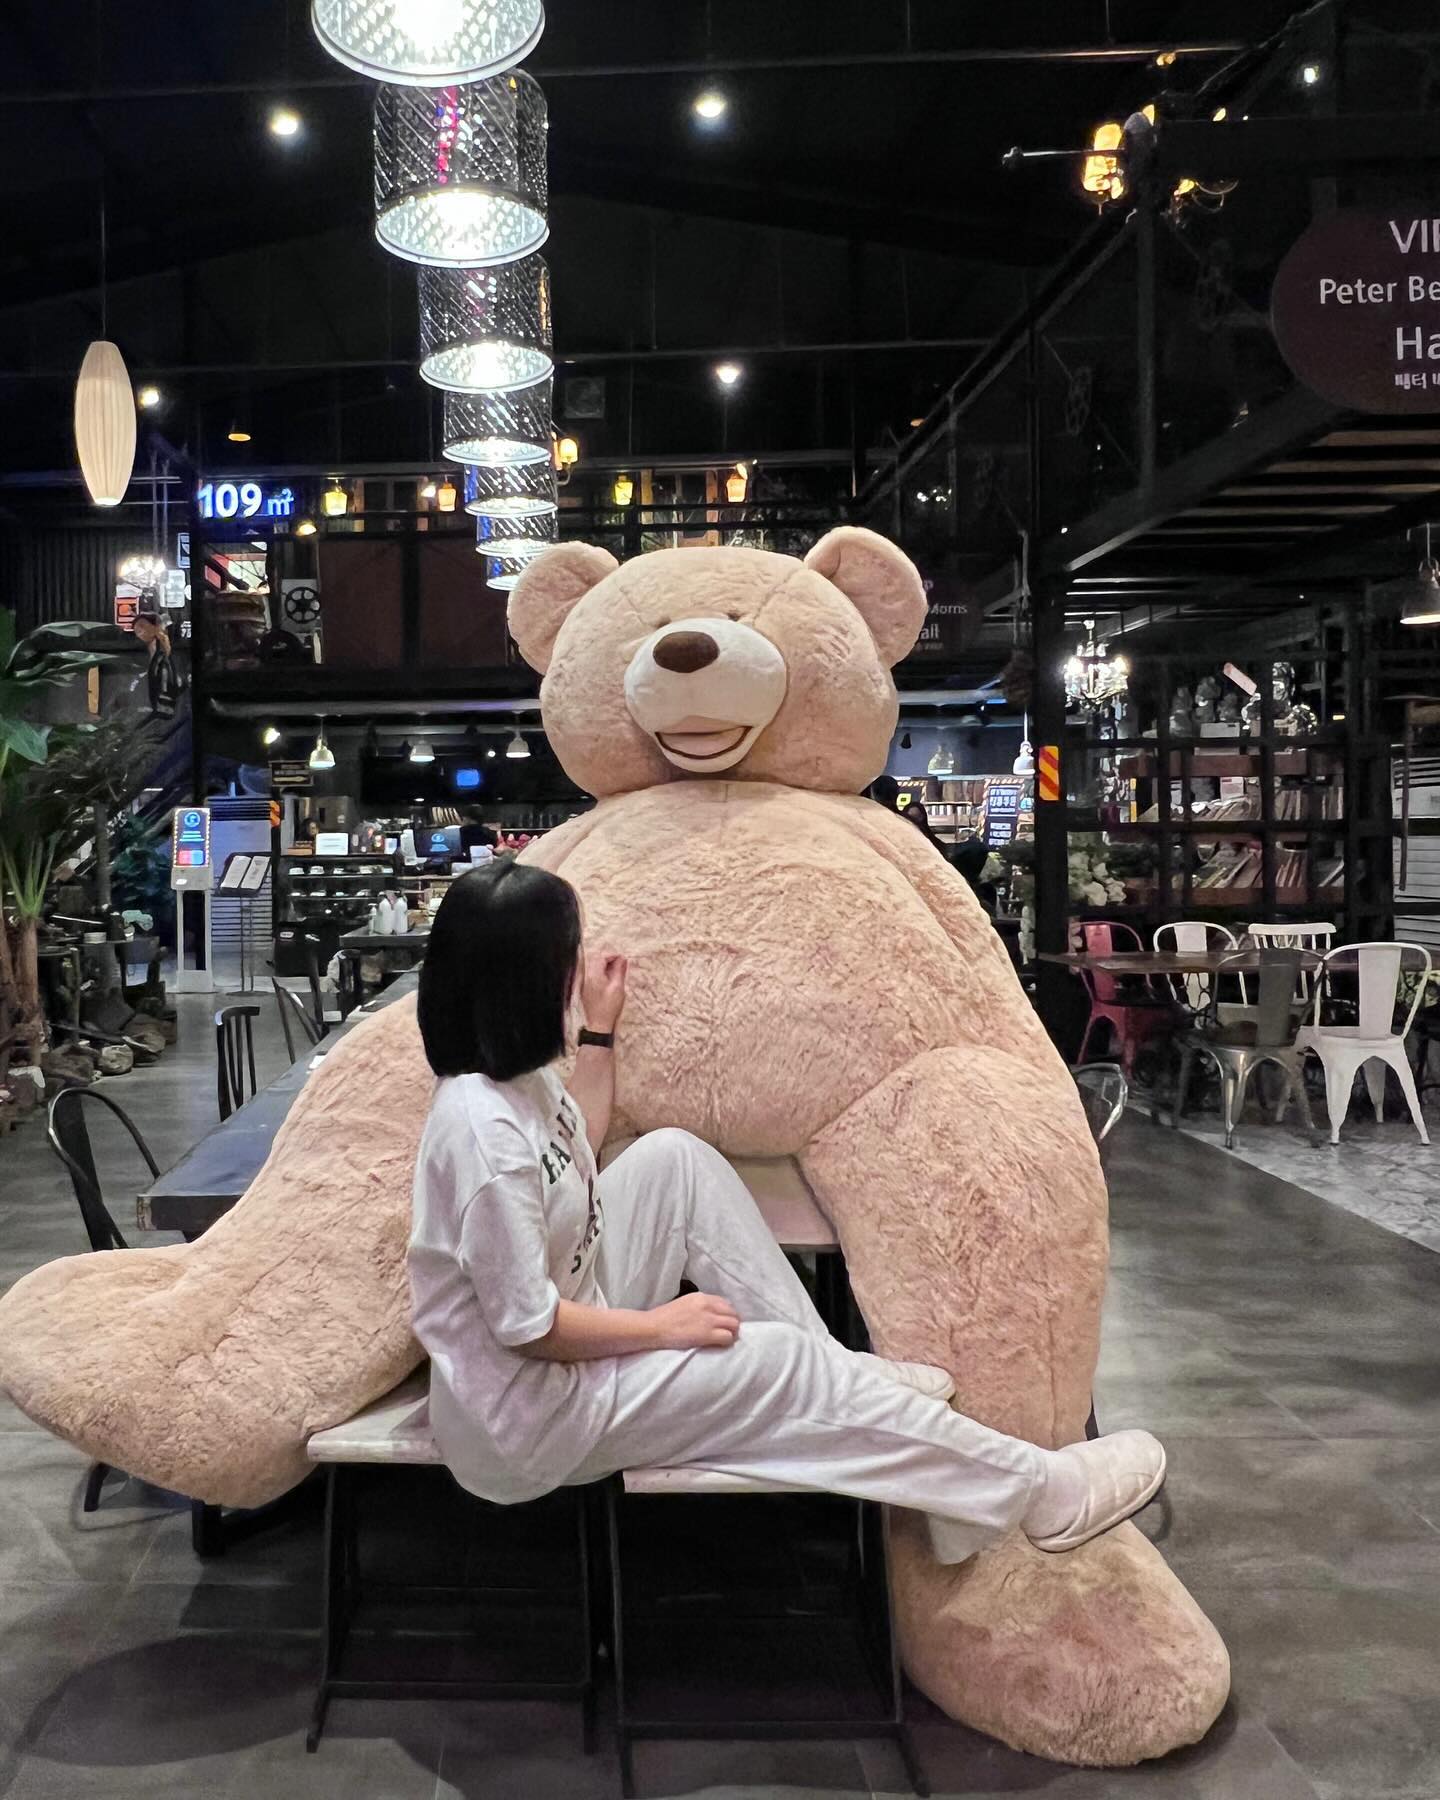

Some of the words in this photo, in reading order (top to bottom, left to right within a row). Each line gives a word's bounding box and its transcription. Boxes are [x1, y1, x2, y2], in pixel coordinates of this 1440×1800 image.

[1319, 278, 1397, 304] Peter
[197, 483, 262, 518] 109
[920, 623, 939, 640] all
